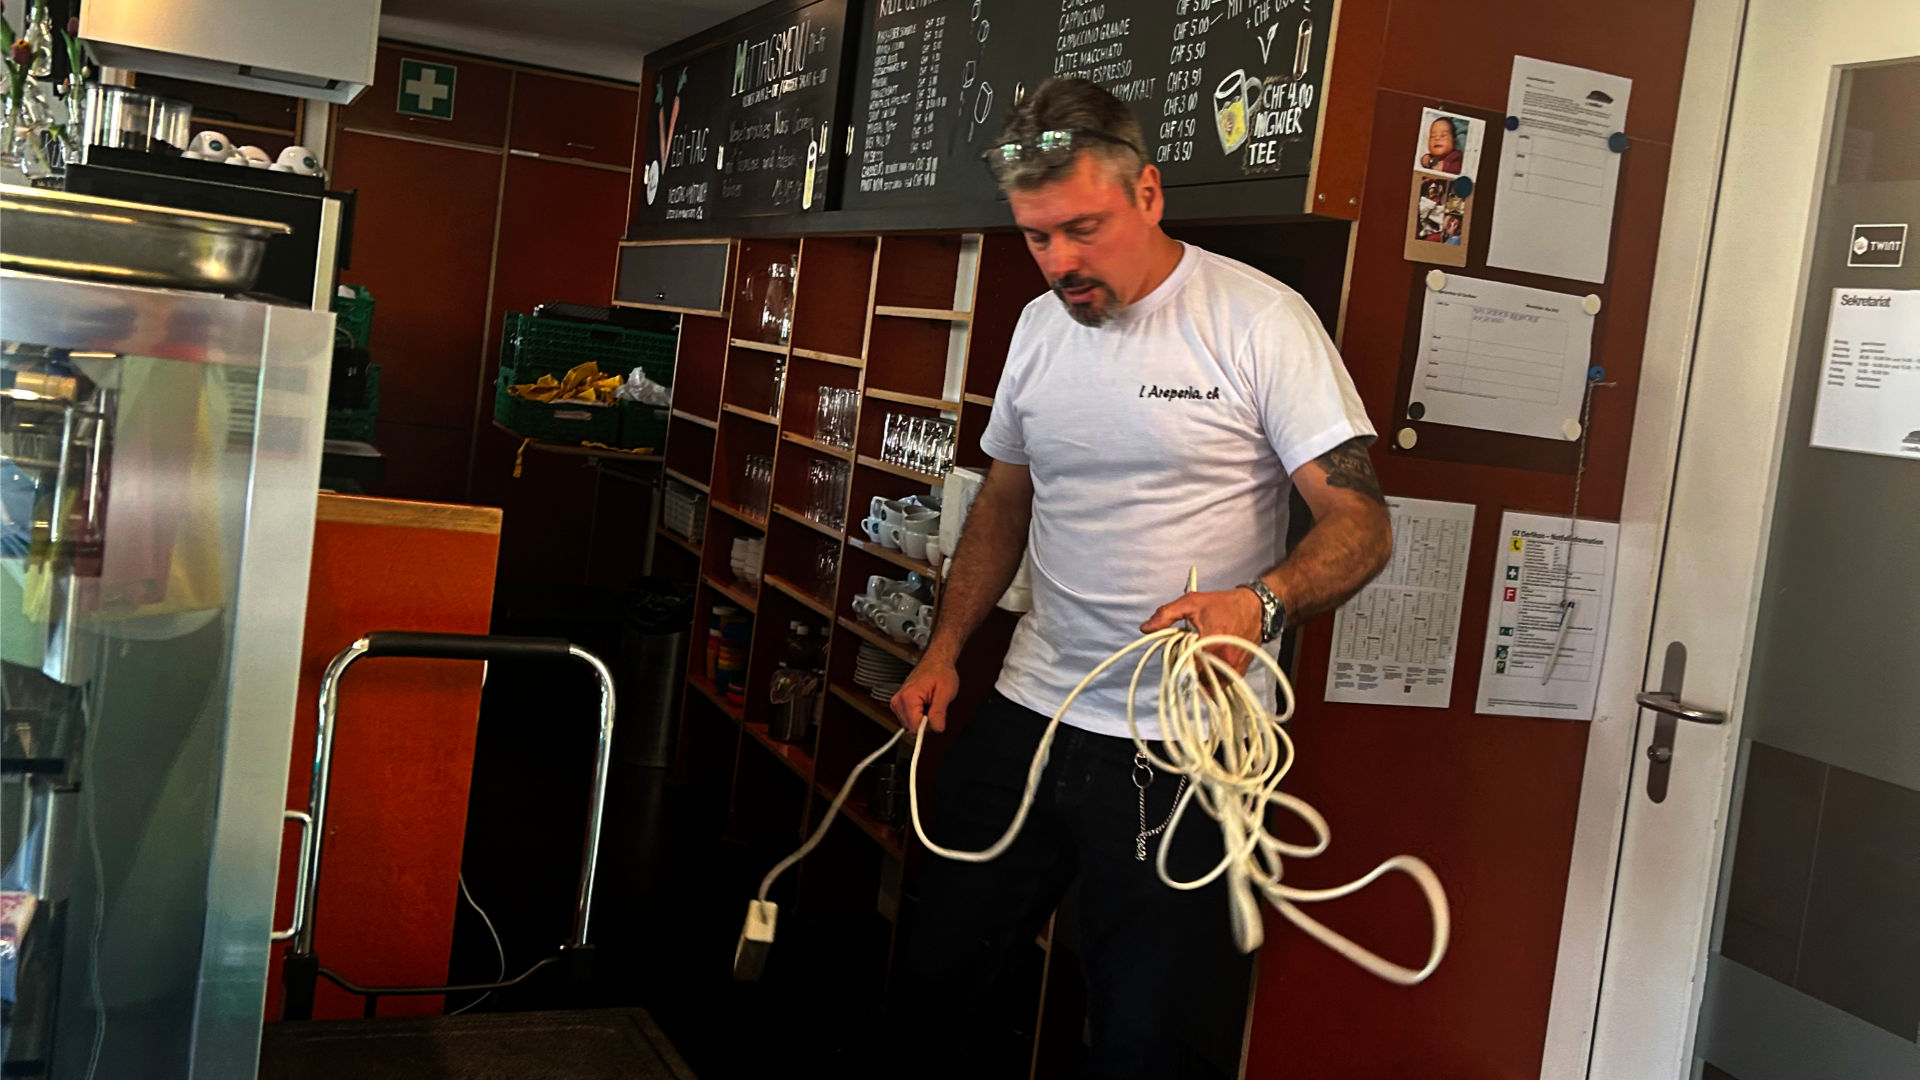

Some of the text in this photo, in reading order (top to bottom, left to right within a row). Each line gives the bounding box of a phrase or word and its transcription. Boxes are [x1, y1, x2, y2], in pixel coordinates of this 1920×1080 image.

[1059, 4, 1105, 33] CAPPUCCINO
[1173, 16, 1210, 42] CHF 5.00
[1057, 18, 1131, 52] CAPPUCCINO GRANDE
[1054, 43, 1123, 74] LATTE MACCHIATO
[1170, 41, 1206, 65] CHF 5.50
[1093, 59, 1132, 84] ESPRESSO
[1167, 70, 1183, 92] CHF
[1163, 98, 1180, 117] CHF
[1263, 83, 1287, 110] CHF
[1159, 120, 1177, 139] CHF
[1156, 143, 1172, 163] CHF
[1249, 140, 1278, 166] TEE
[1870, 241, 1902, 251] TWINT
[1840, 294, 1892, 308] Sekretariat
